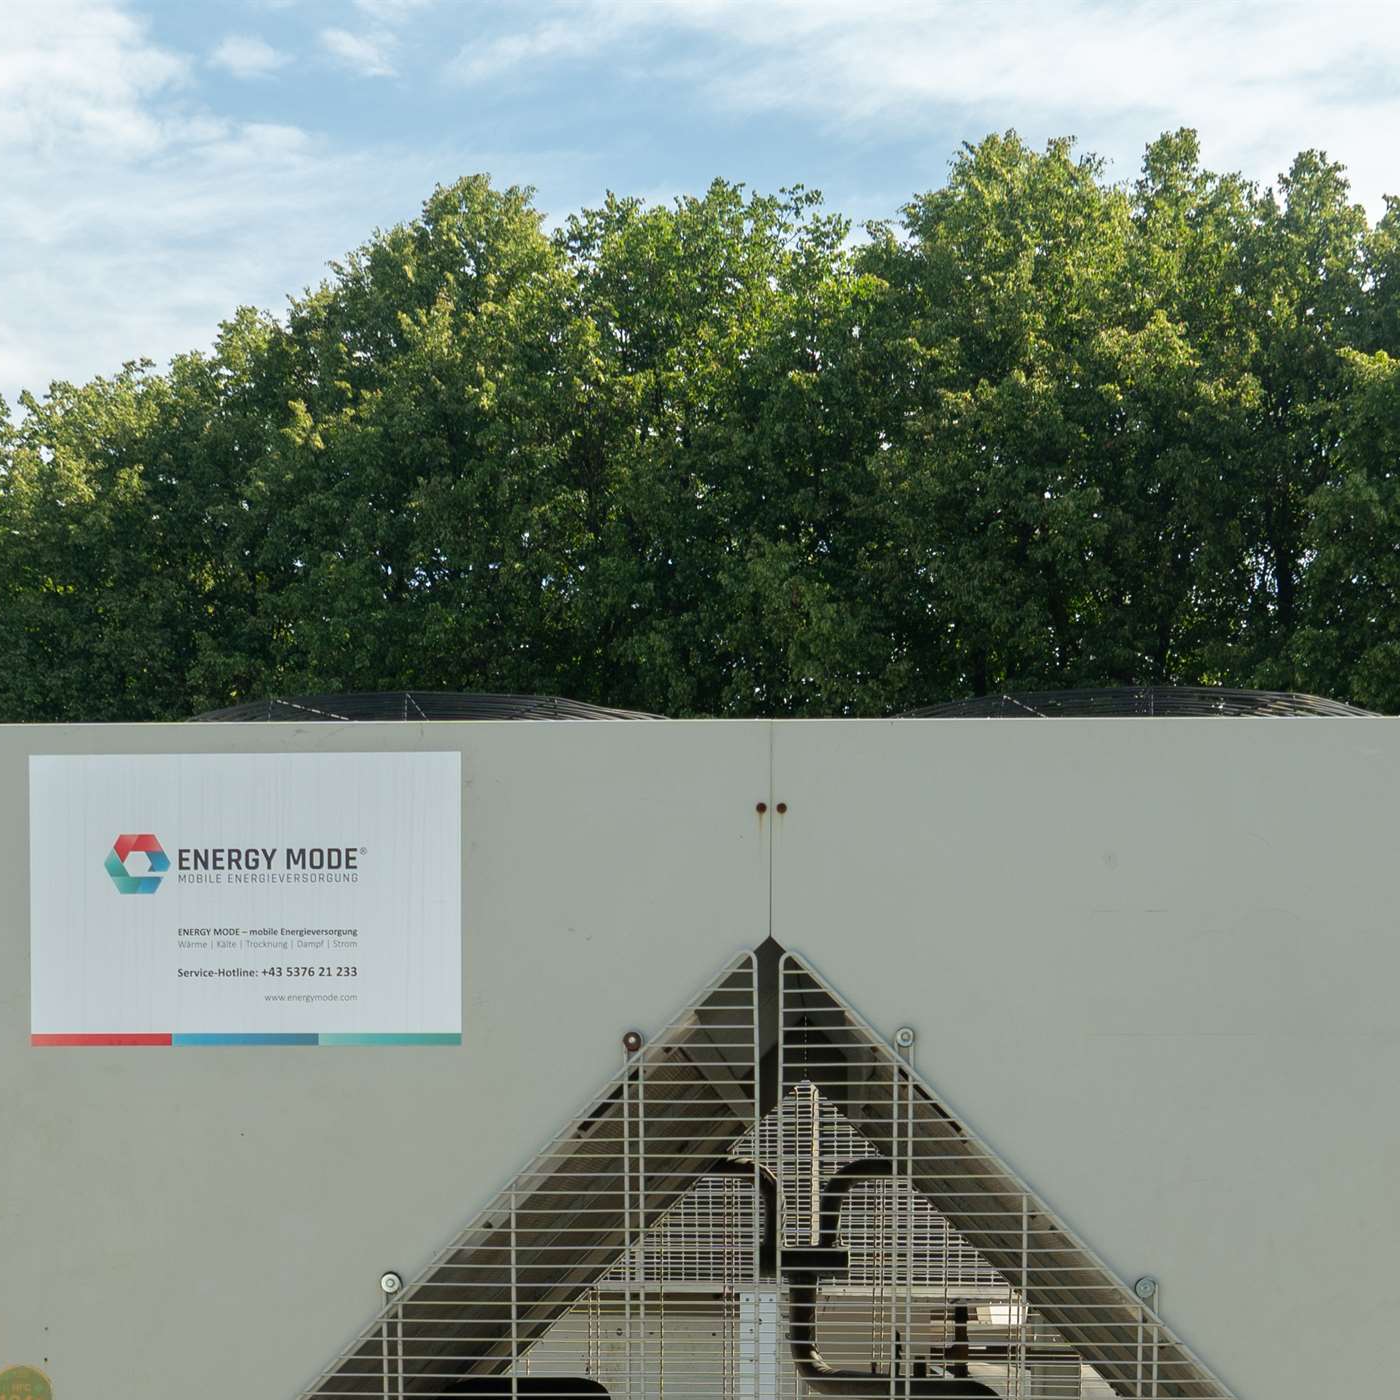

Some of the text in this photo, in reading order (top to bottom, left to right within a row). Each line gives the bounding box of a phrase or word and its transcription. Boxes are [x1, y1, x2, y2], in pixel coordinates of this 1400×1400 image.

[178, 848, 277, 871] ENERGY
[178, 873, 358, 883] MOBILE ENERGIEVERSORGUNG
[178, 928, 212, 936] ENERGY
[213, 928, 240, 936] MODE
[249, 927, 278, 936] mobile
[280, 927, 358, 938] Energieversorgung
[177, 967, 358, 978] Service-Hotline: +43 5376 21 233
[264, 992, 358, 1003] www.energymode.com
